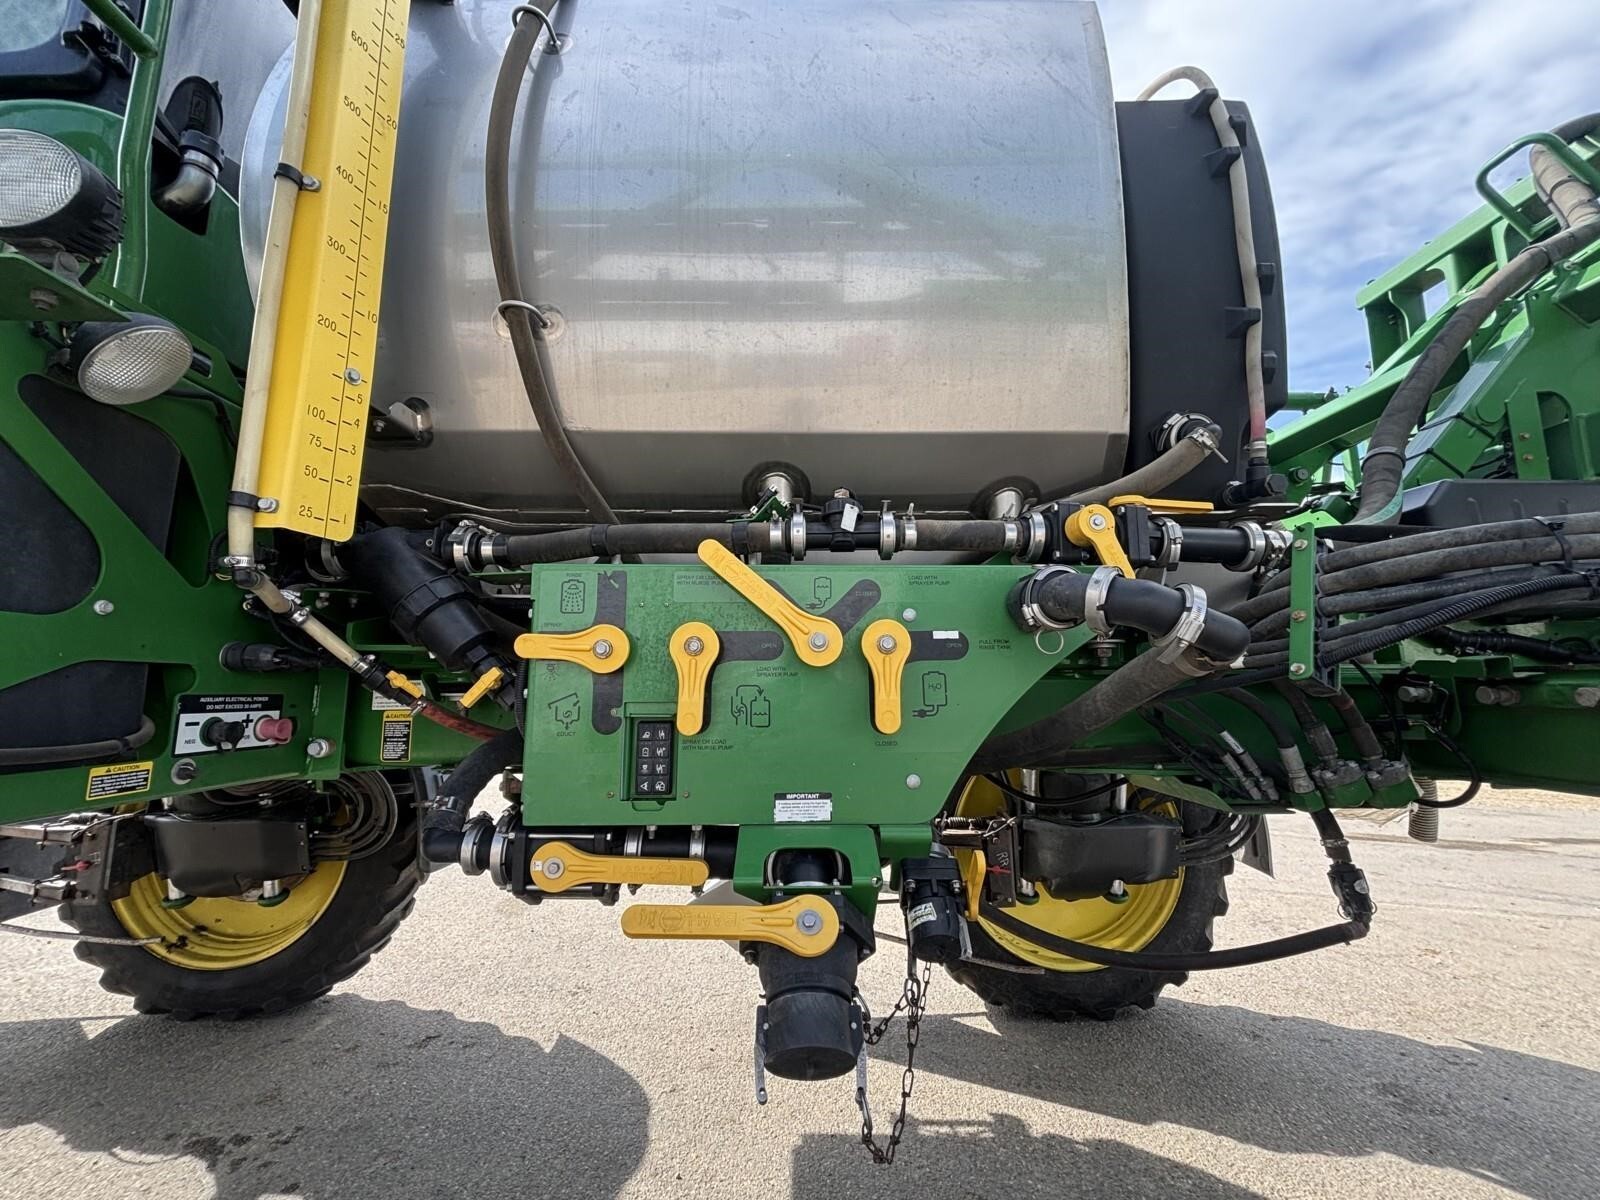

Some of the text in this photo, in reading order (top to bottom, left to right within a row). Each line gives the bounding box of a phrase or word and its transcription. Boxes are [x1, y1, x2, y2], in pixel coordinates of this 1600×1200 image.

[350, 30, 369, 53] 600
[394, 32, 406, 49] 25
[343, 95, 361, 117] 500
[385, 114, 397, 131] 20
[335, 164, 354, 185] 400
[377, 199, 389, 215] 15
[326, 235, 346, 256] 300
[317, 313, 337, 332] 200
[367, 309, 378, 324] 10
[356, 393, 364, 405] 5
[306, 404, 326, 421] 100
[353, 418, 361, 430] 4
[308, 433, 323, 448] 75
[349, 444, 357, 456] 3
[303, 465, 319, 479] 50
[346, 475, 353, 487] 2
[298, 504, 314, 519] 25
[112, 764, 140, 773] CAUTION
